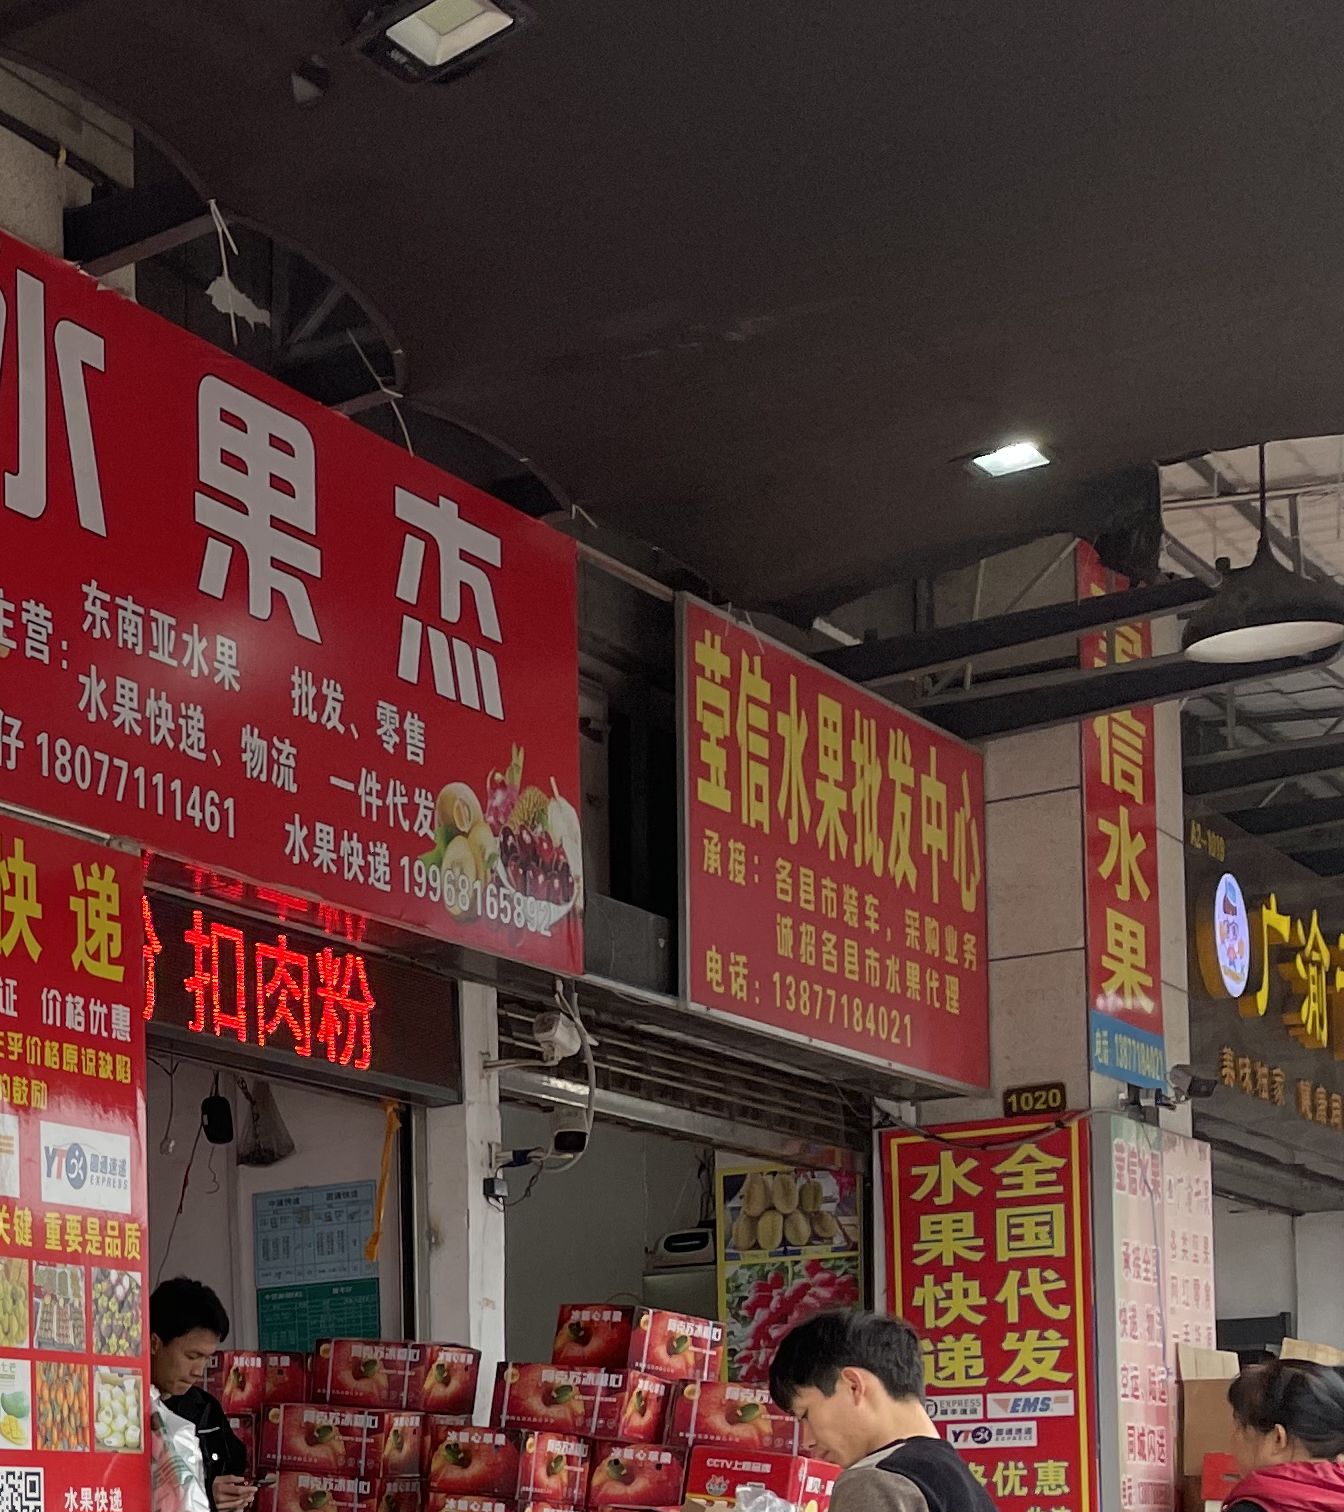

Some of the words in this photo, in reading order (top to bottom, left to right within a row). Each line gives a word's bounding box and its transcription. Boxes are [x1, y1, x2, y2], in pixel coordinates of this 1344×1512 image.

[80, 579, 241, 693] 东南亚水果
[291, 665, 428, 767] 批发、零售
[78, 668, 299, 795] 水果快递、物流
[328, 767, 435, 839] 一件代发
[695, 629, 982, 912] 莹信水果批发中心
[35, 730, 236, 840] 18077111461
[284, 812, 392, 894] 水果快递
[400, 854, 551, 938] 19968165892
[41, 986, 132, 1043] 价格优惠
[184, 910, 376, 1071] 扣肉粉
[773, 971, 913, 1047] 13877184021
[776, 913, 961, 1016] 诚招各县市水果代理
[1007, 1088, 1064, 1114] 1020
[44, 1210, 142, 1261] 重要是品质
[89, 1173, 129, 1191] EXPRESS
[910, 1149, 989, 1390] 水果快递
[991, 1142, 1075, 1387] 全国代发
[1009, 1396, 1053, 1415] EMS
